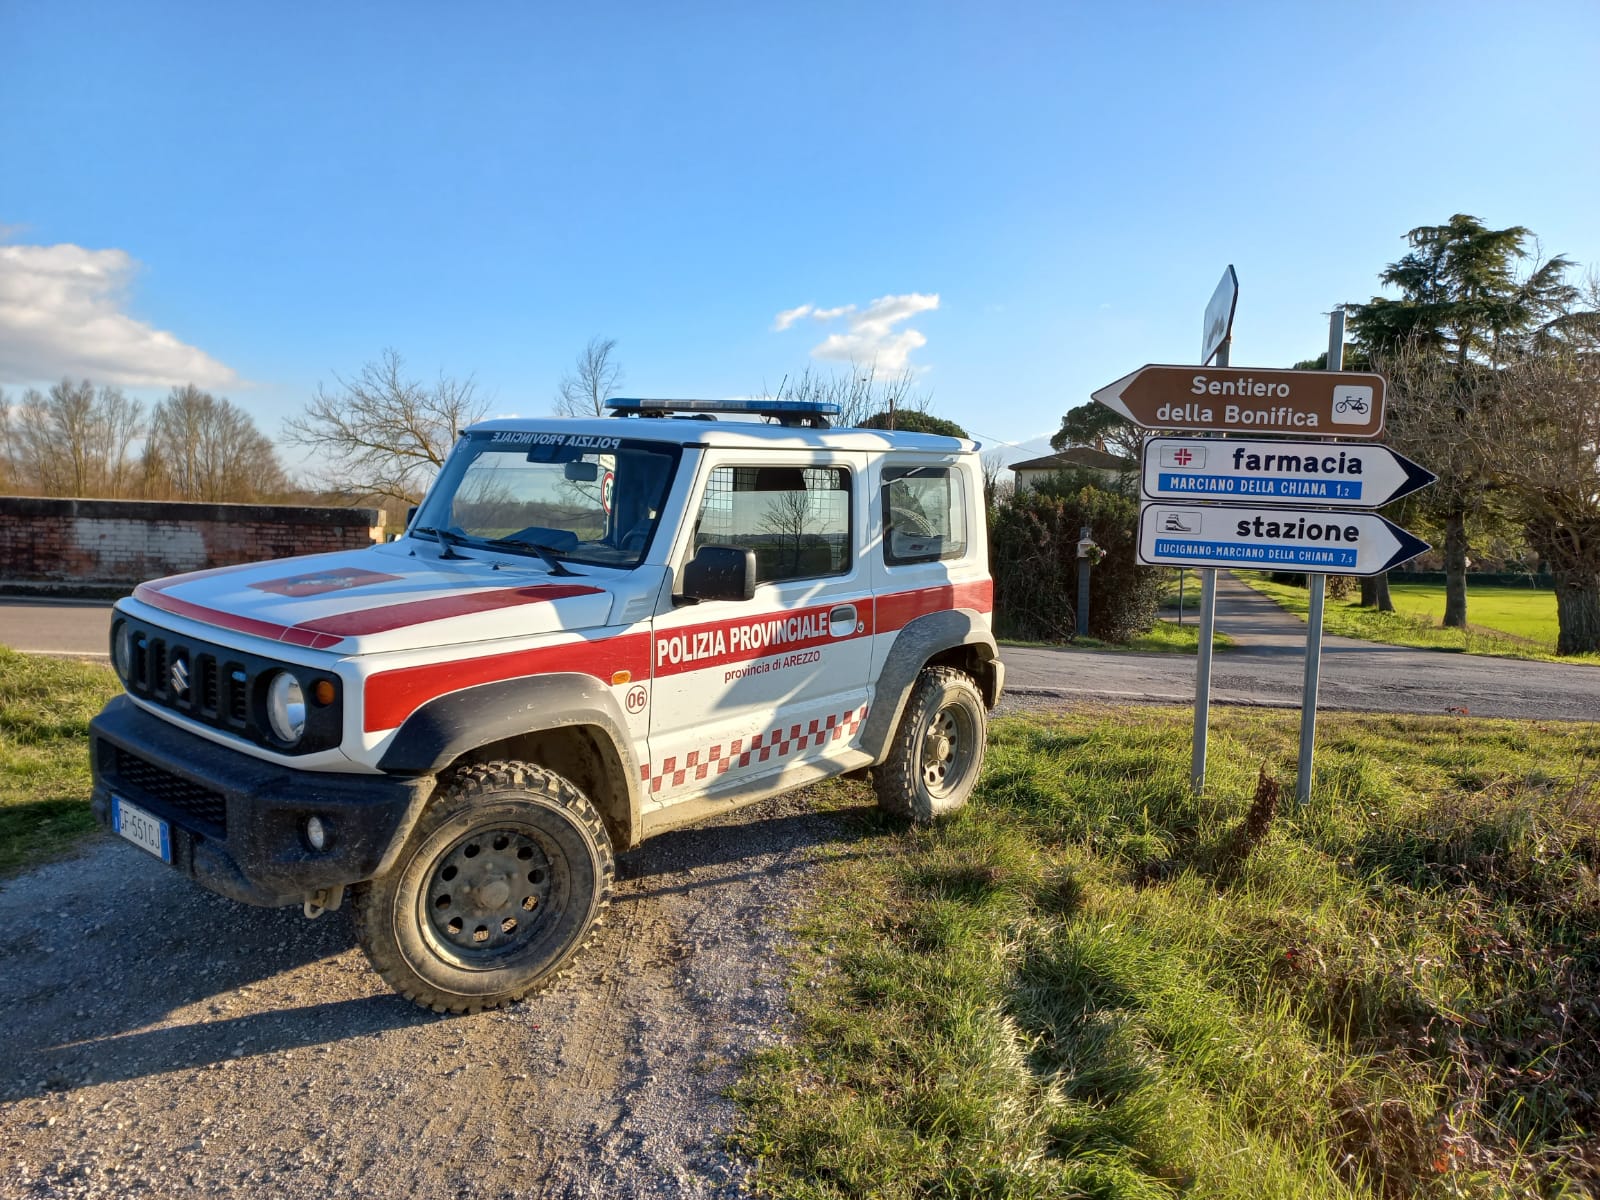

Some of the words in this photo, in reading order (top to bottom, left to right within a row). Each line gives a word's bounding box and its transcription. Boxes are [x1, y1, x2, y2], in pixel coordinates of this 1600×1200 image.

[1191, 376, 1290, 398] Sentiero
[1156, 403, 1213, 423] della
[1224, 405, 1319, 427] Bonifica
[1232, 447, 1363, 475] farmacia
[1170, 477, 1235, 492] MARCIANO
[1240, 481, 1275, 494] DELLA
[1280, 482, 1327, 496] CHIANA
[1236, 516, 1360, 543] stazione
[1268, 550, 1295, 561] DELLA
[1298, 550, 1334, 562] CHIANA
[657, 629, 726, 667] POLIZIA
[730, 612, 828, 653] PROVINCIALE
[724, 663, 770, 684] provincia
[772, 658, 781, 672] di
[783, 650, 821, 670] AREZZO
[627, 689, 645, 709] 06
